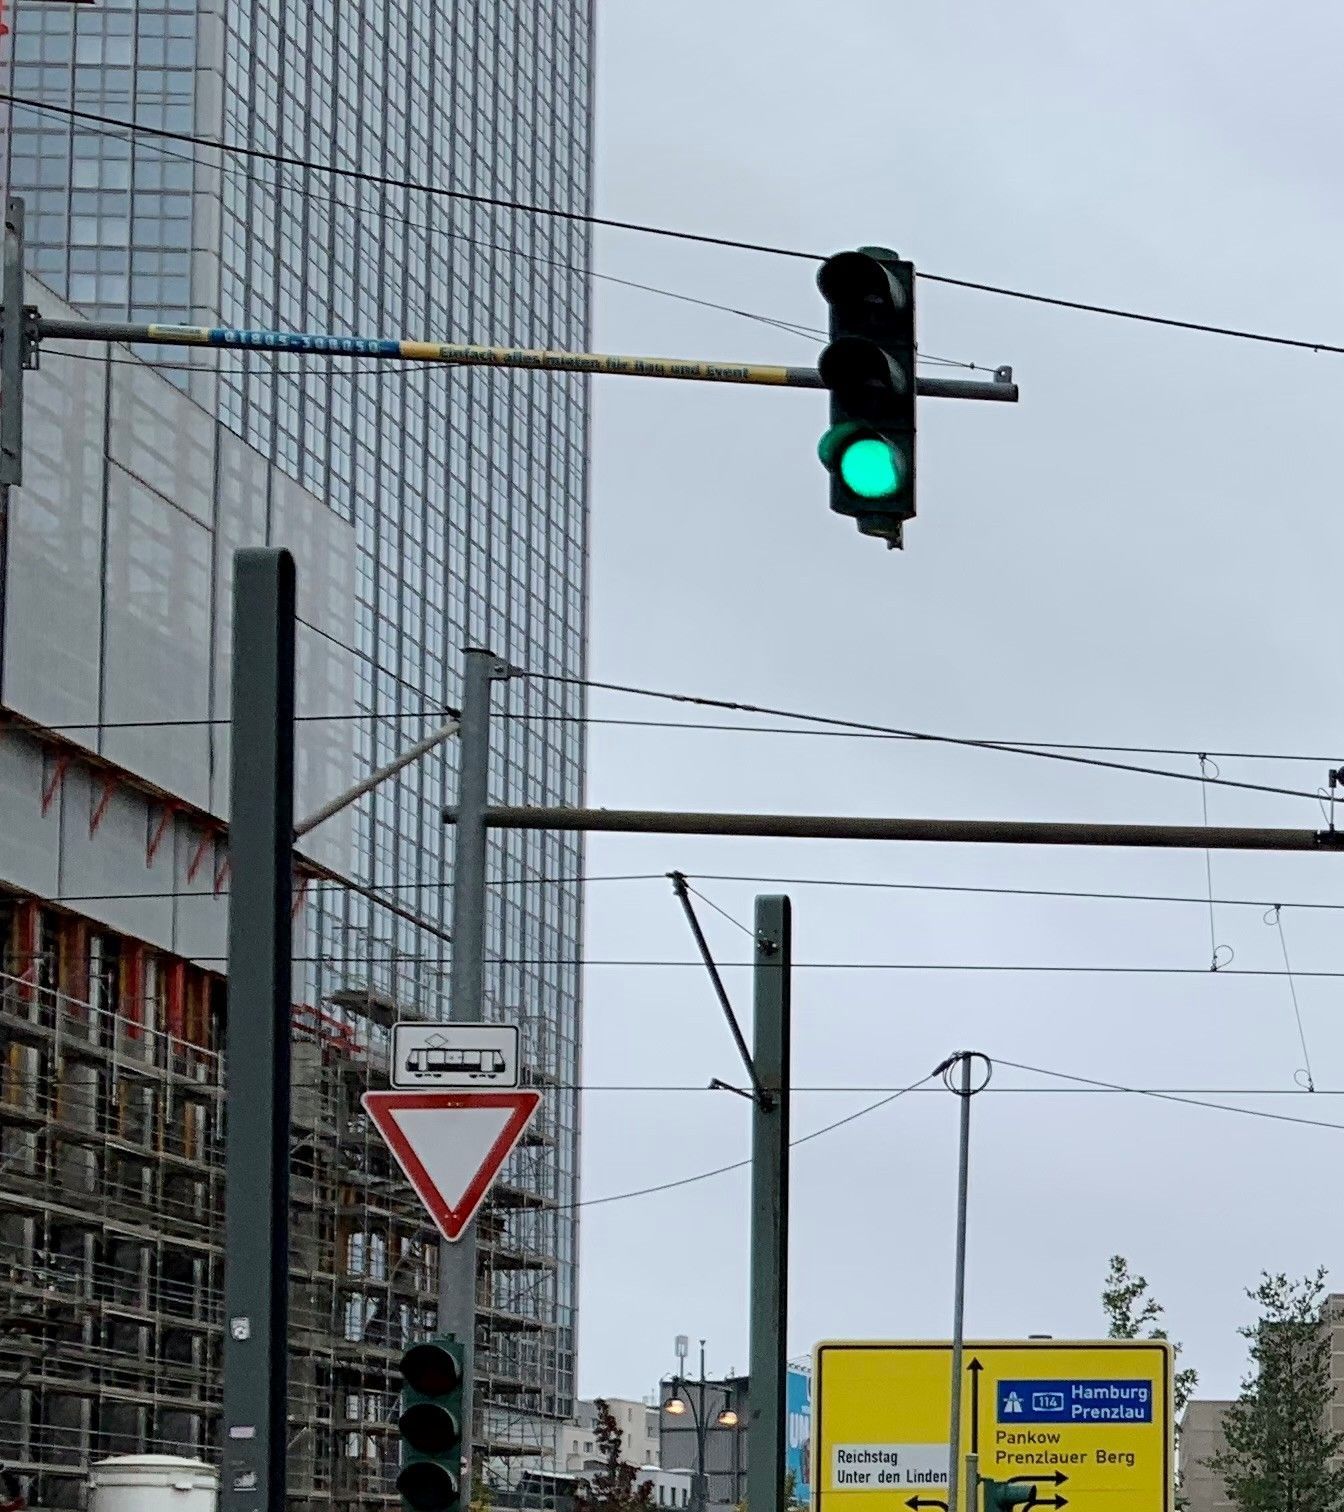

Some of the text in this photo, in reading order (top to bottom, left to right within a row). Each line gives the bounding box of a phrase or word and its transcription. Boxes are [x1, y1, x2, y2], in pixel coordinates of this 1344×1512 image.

[1071, 1385, 1148, 1401] Hamburg
[1039, 1396, 1058, 1407] 114
[1071, 1405, 1145, 1419] Prenzlau
[996, 1431, 1060, 1444] Pankow
[837, 1449, 899, 1467] Reichstag
[996, 1450, 1135, 1466] Prenzlauer Berg
[837, 1468, 947, 1483] Unter den Linden
